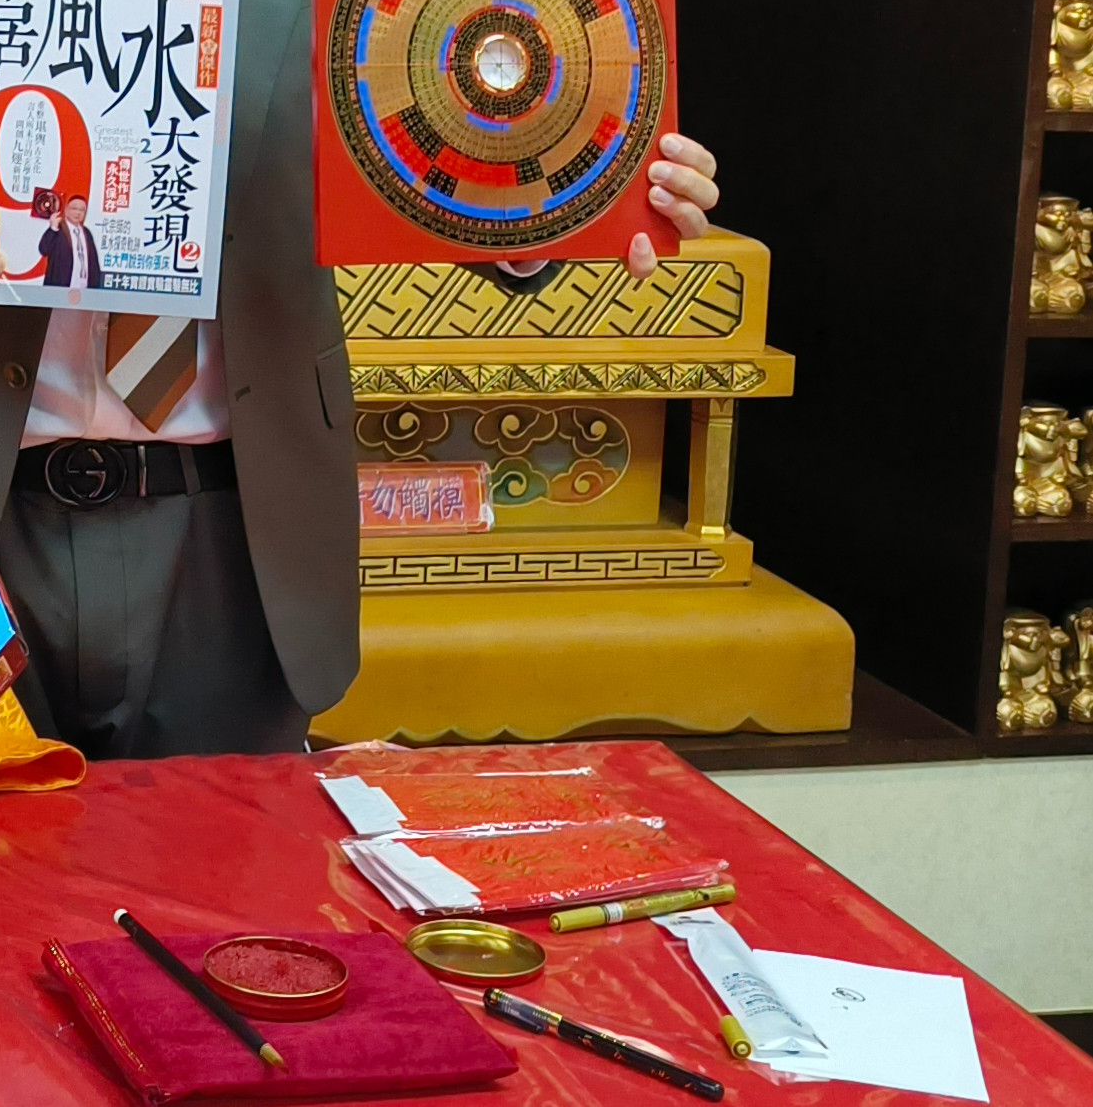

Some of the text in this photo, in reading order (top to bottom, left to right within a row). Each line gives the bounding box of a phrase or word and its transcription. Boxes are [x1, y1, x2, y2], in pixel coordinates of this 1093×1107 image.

[140, 138, 152, 154] 2
[138, 117, 201, 273] 大發現
[181, 242, 200, 262] 2
